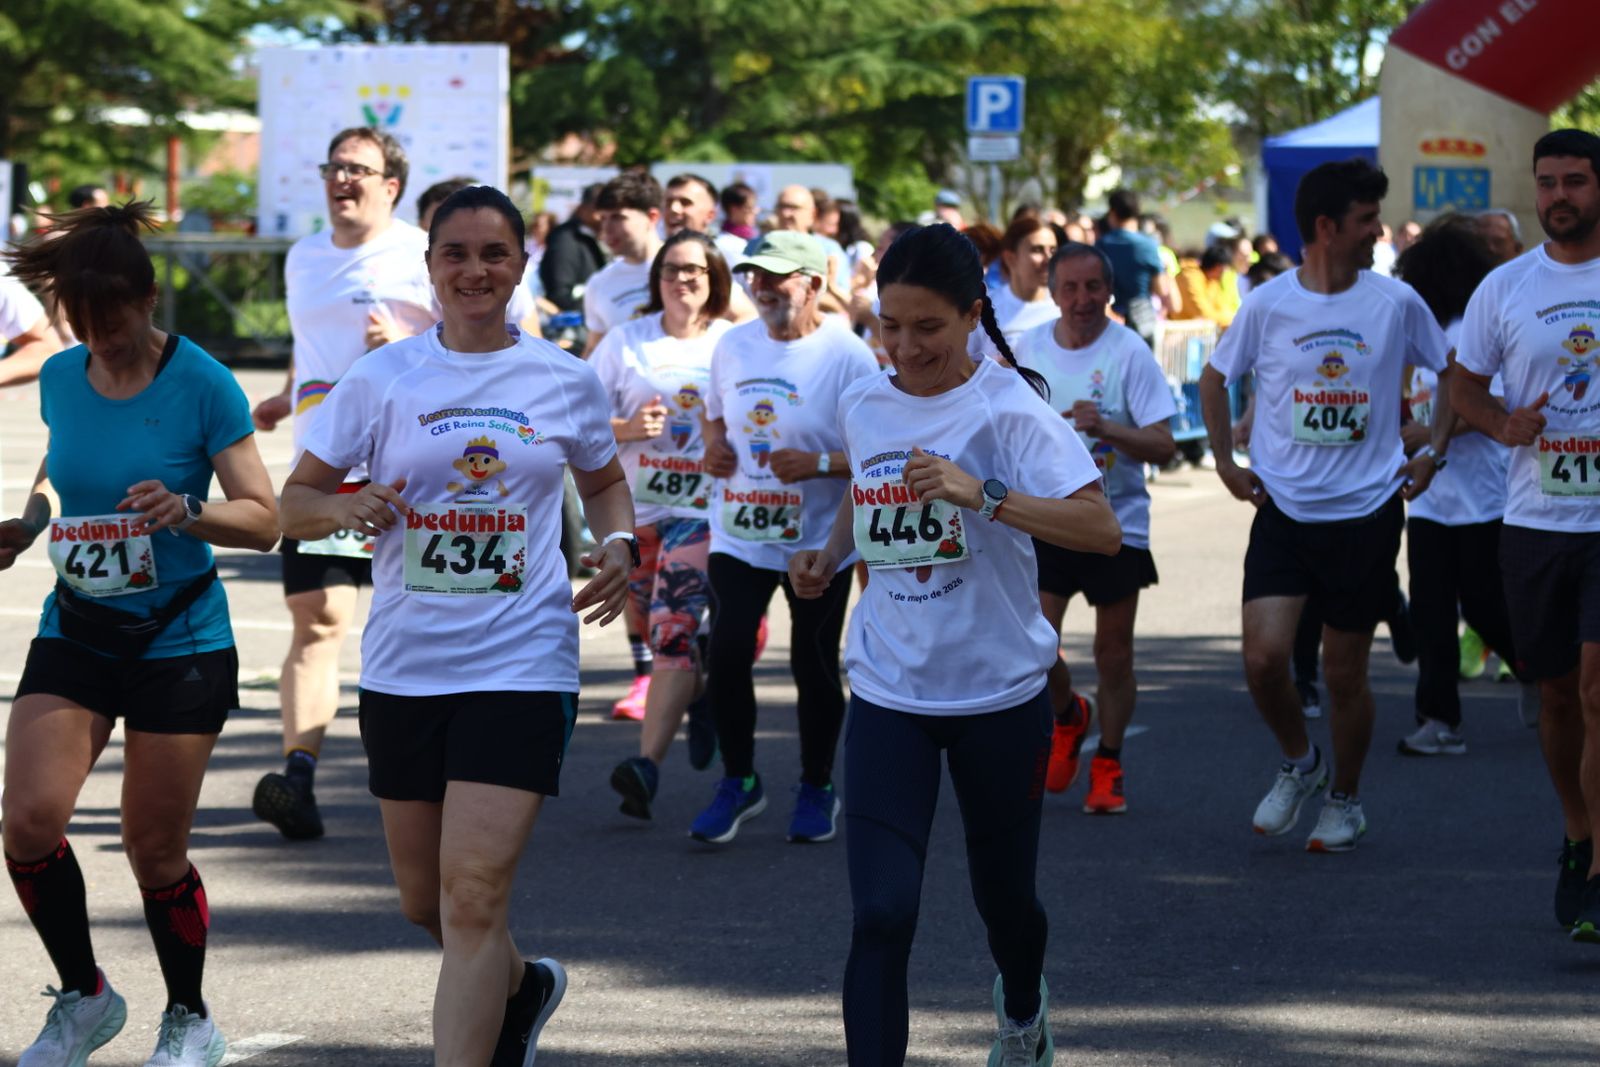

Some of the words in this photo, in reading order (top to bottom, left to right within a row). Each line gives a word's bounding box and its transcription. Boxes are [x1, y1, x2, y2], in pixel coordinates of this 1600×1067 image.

[1446, 17, 1502, 70] CON
[975, 84, 1012, 130] P
[1294, 388, 1368, 406] bedunia
[426, 407, 474, 423] carrera
[473, 407, 530, 426] solidaria
[431, 422, 452, 436] CEE
[453, 420, 485, 429] Reina
[1303, 406, 1358, 432] 404
[639, 453, 704, 472] beduni
[648, 471, 703, 498] 487
[724, 488, 801, 506] bedunia
[852, 482, 921, 507] bedu
[406, 508, 526, 533] bedunia
[734, 506, 788, 530] 484
[869, 502, 943, 547] 446
[65, 541, 130, 579] 421
[421, 534, 507, 576] 434
[894, 592, 906, 602] de
[930, 589, 942, 599] de
[942, 576, 964, 595] 2026
